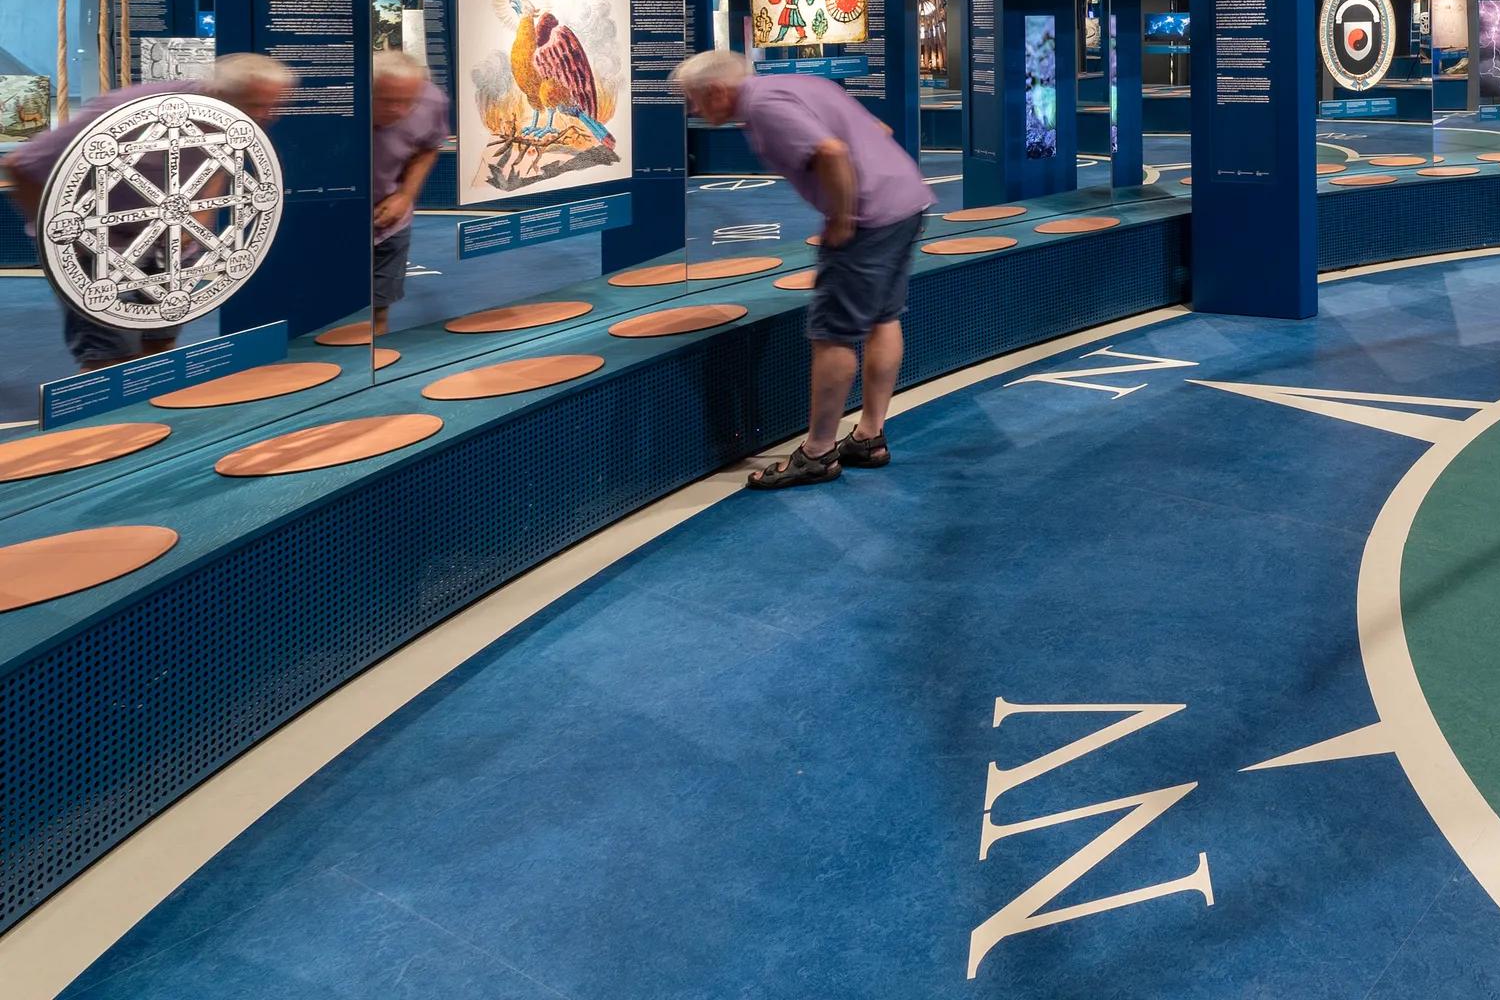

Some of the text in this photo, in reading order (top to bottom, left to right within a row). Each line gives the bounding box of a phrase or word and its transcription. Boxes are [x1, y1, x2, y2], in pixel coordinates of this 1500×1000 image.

[112, 109, 156, 138] REMISSA
[250, 142, 272, 179] REMISSA
[62, 243, 91, 290] REMISSA
[190, 277, 232, 305] REMISSA
[1003, 346, 1200, 400] N
